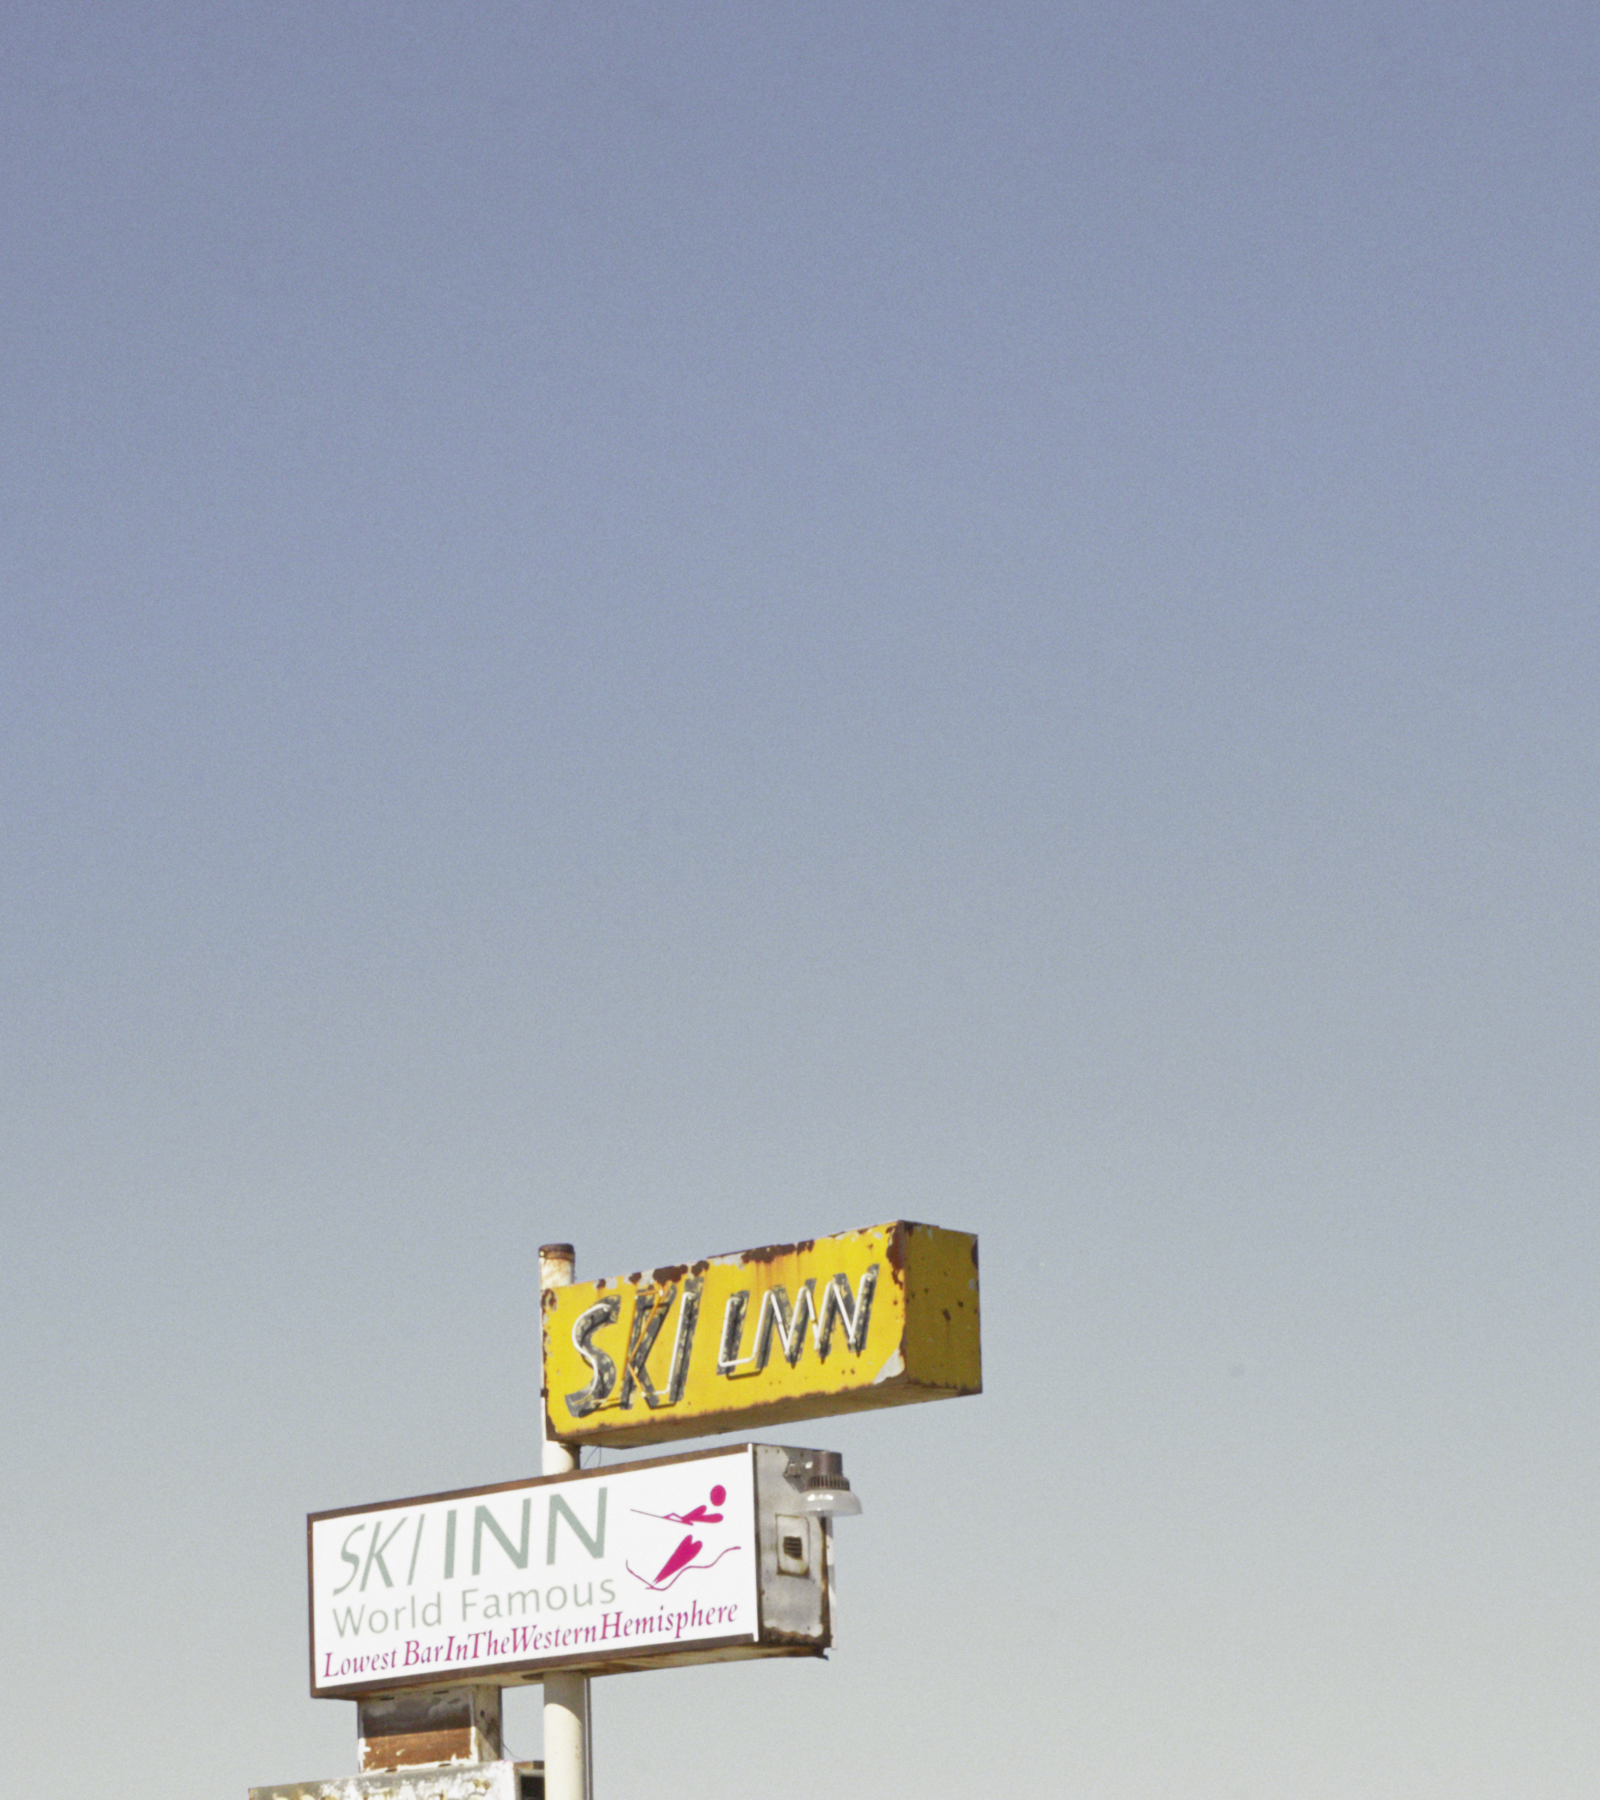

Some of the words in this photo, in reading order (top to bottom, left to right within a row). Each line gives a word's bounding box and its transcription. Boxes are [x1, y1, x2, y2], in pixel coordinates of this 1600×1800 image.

[565, 1276, 704, 1419] SKI
[332, 1513, 426, 1597] SKI
[443, 1486, 609, 1580] INN
[332, 1591, 442, 1638] World
[461, 1578, 617, 1622] Famous
[323, 1647, 397, 1678] Lowest
